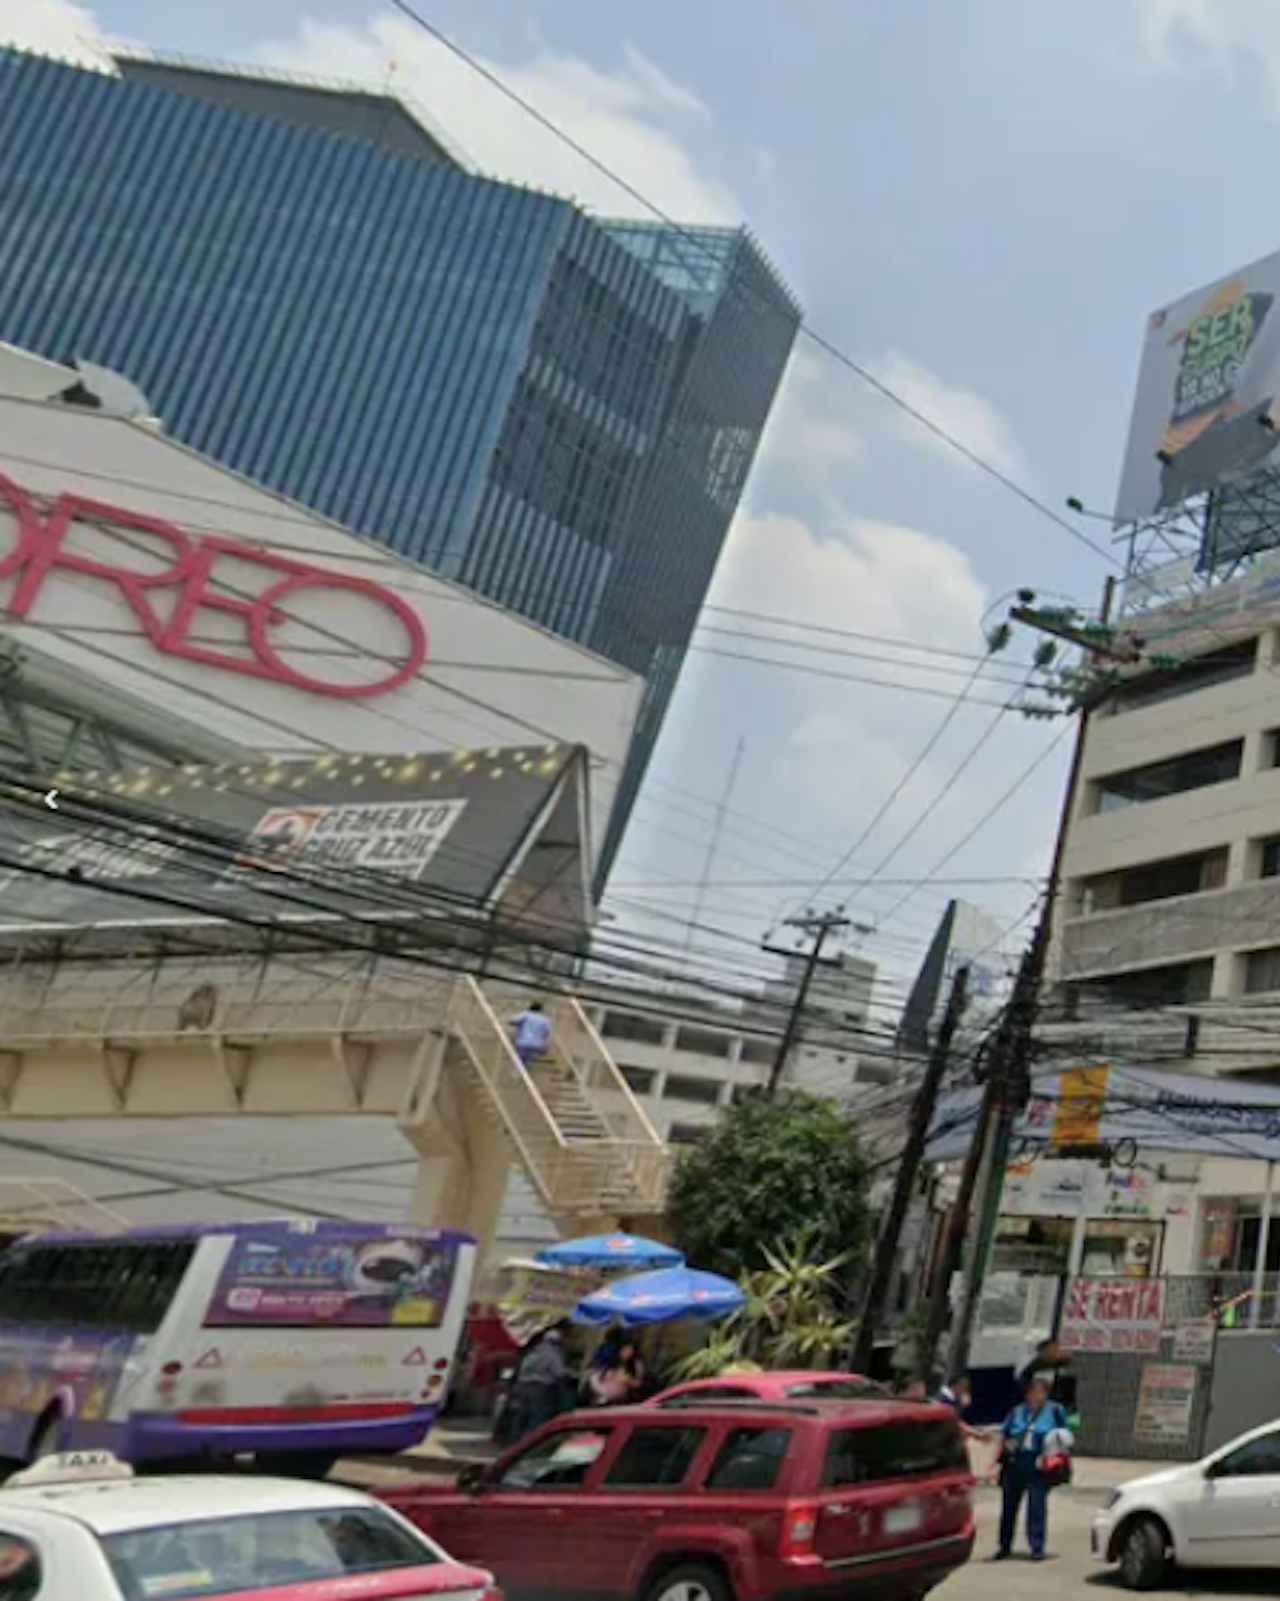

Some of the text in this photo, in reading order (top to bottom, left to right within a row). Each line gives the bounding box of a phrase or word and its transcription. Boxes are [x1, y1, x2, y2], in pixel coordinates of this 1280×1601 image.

[1186, 297, 1253, 355] SER
[315, 806, 450, 833] CEMENTO
[371, 834, 435, 859] AZUL
[1094, 1280, 1162, 1321] RENTA
